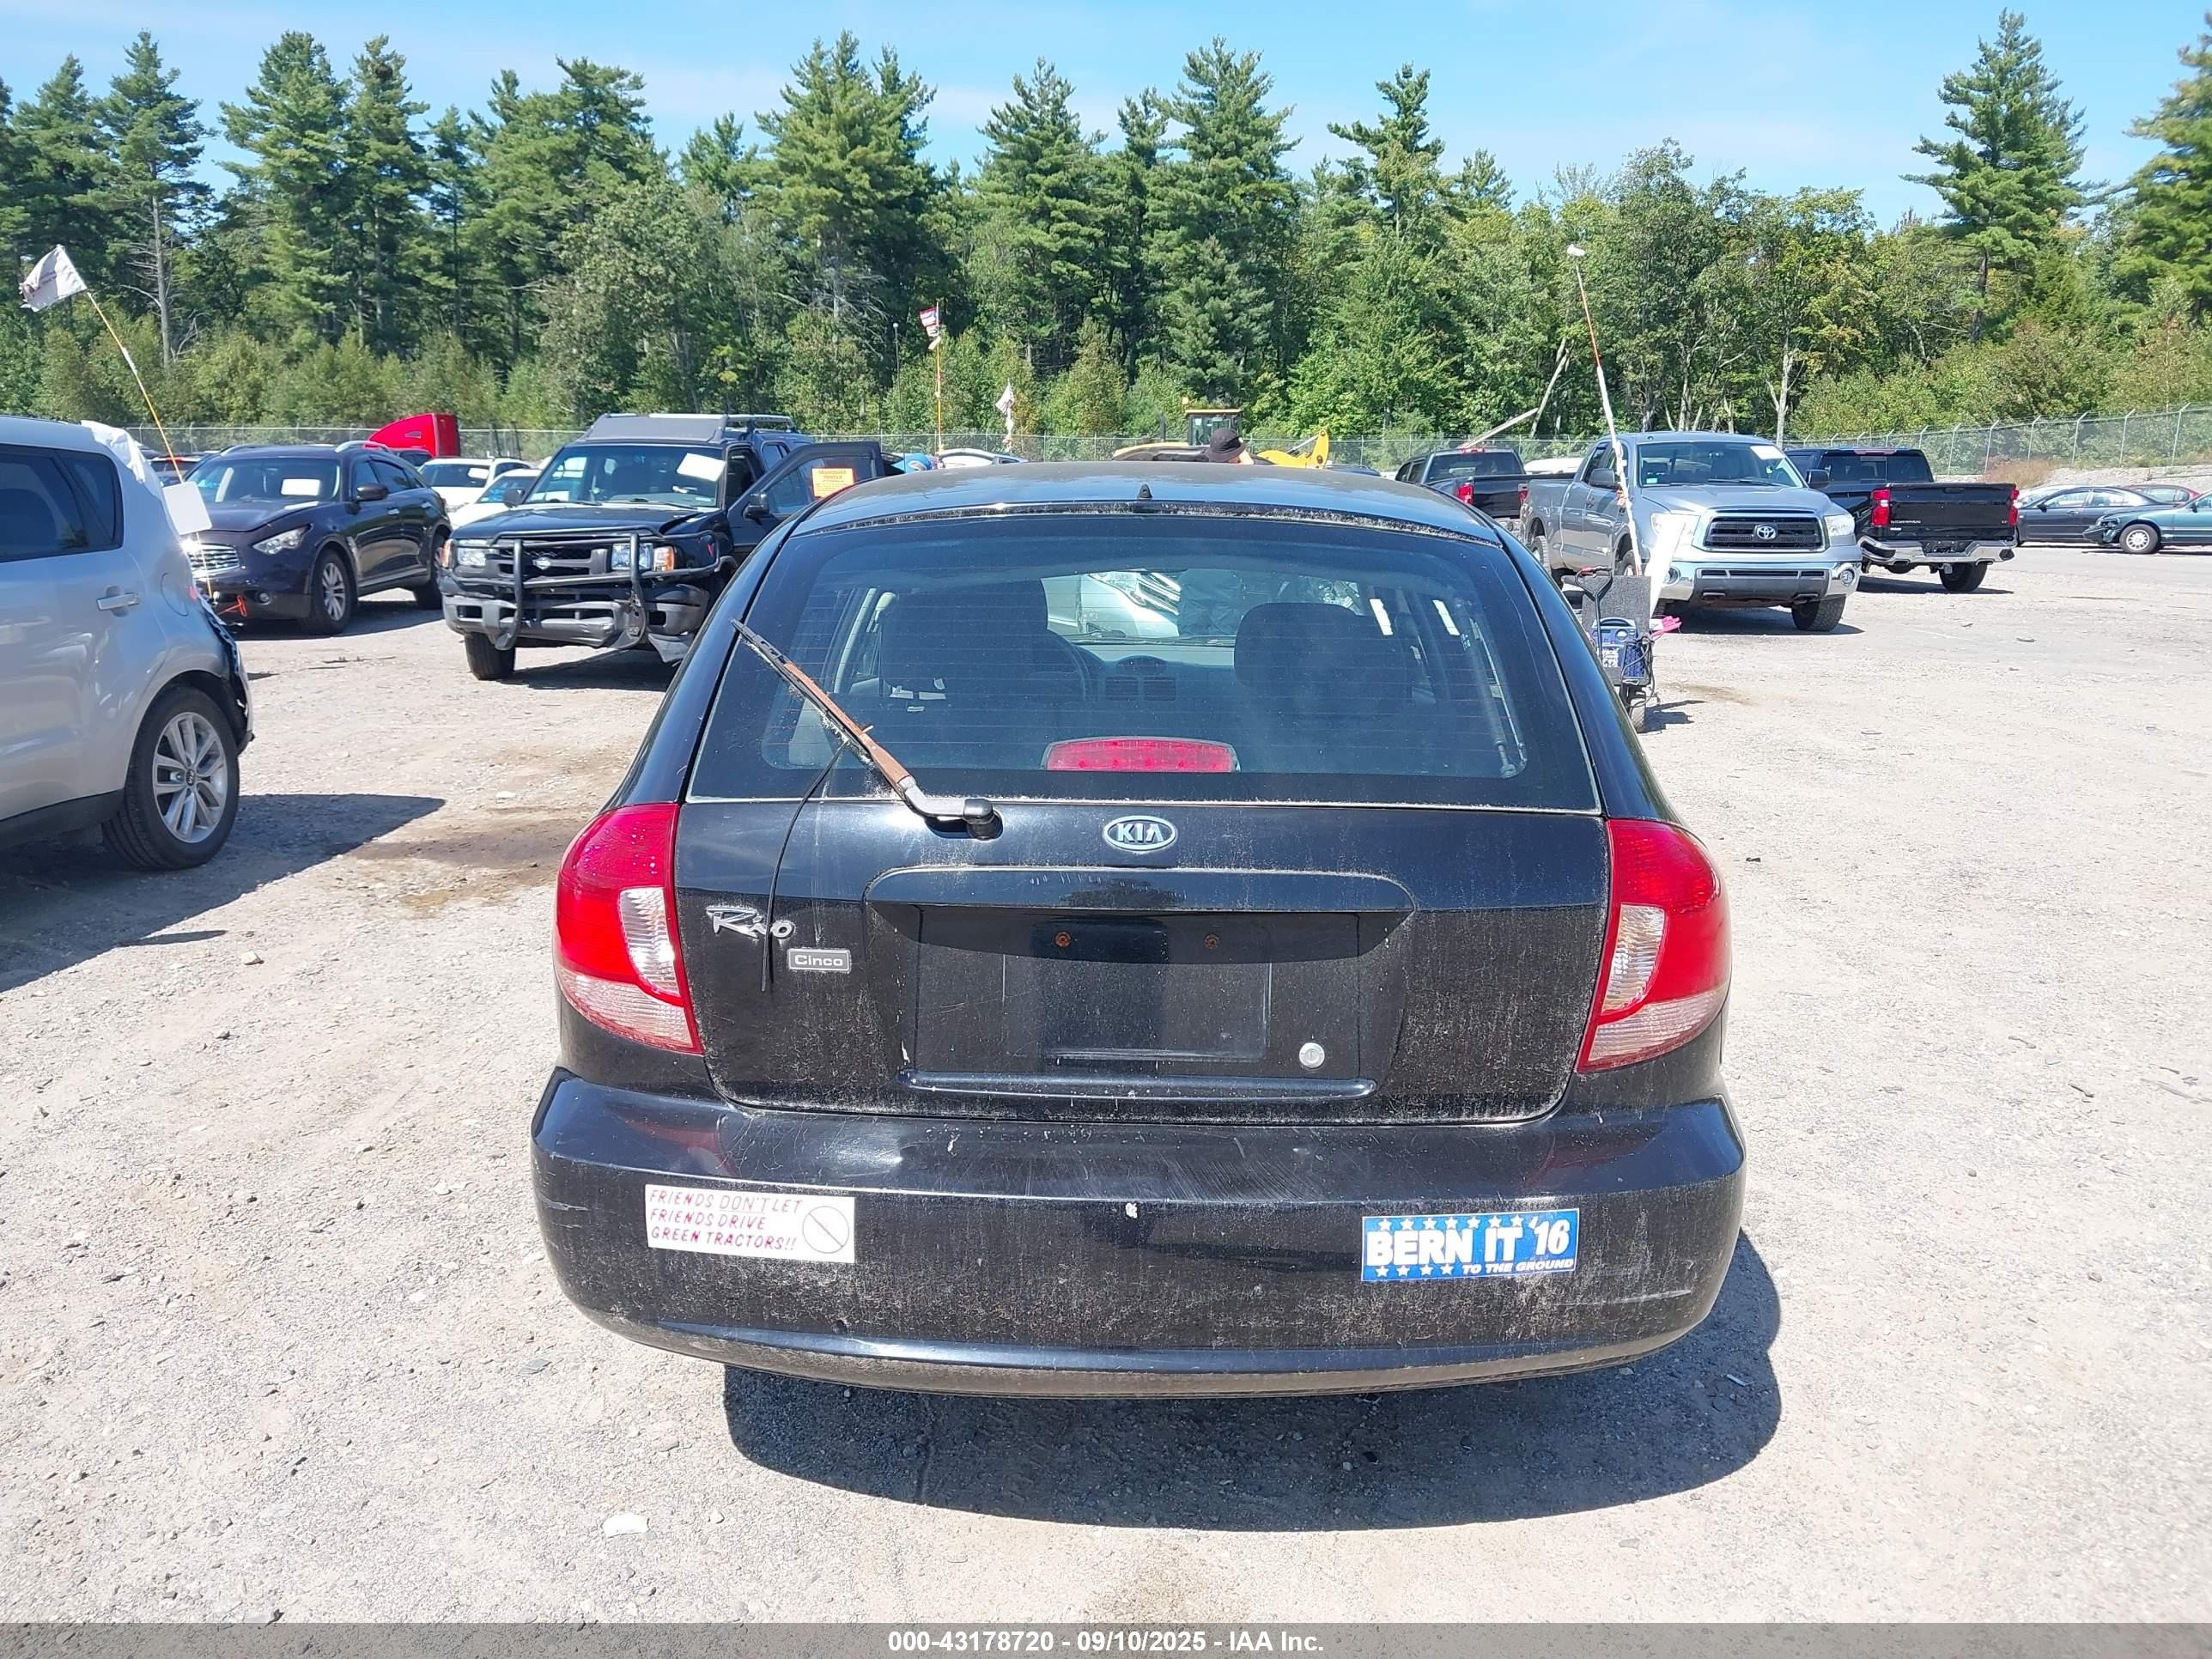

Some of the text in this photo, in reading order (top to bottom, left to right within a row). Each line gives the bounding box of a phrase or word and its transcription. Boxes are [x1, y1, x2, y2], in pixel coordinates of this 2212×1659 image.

[1116, 823, 1164, 842] KIA
[706, 904, 796, 939] Rio
[794, 954, 843, 967] Cinco
[649, 1189, 803, 1214] FRIENDS DON'T LET
[650, 1208, 767, 1230] FRIENDS DRIVE
[651, 1226, 797, 1250] GREEN TRACTORS!!
[1366, 1215, 1571, 1266] BERN IT '16
[1462, 1258, 1574, 1274] TO THE GROUND
